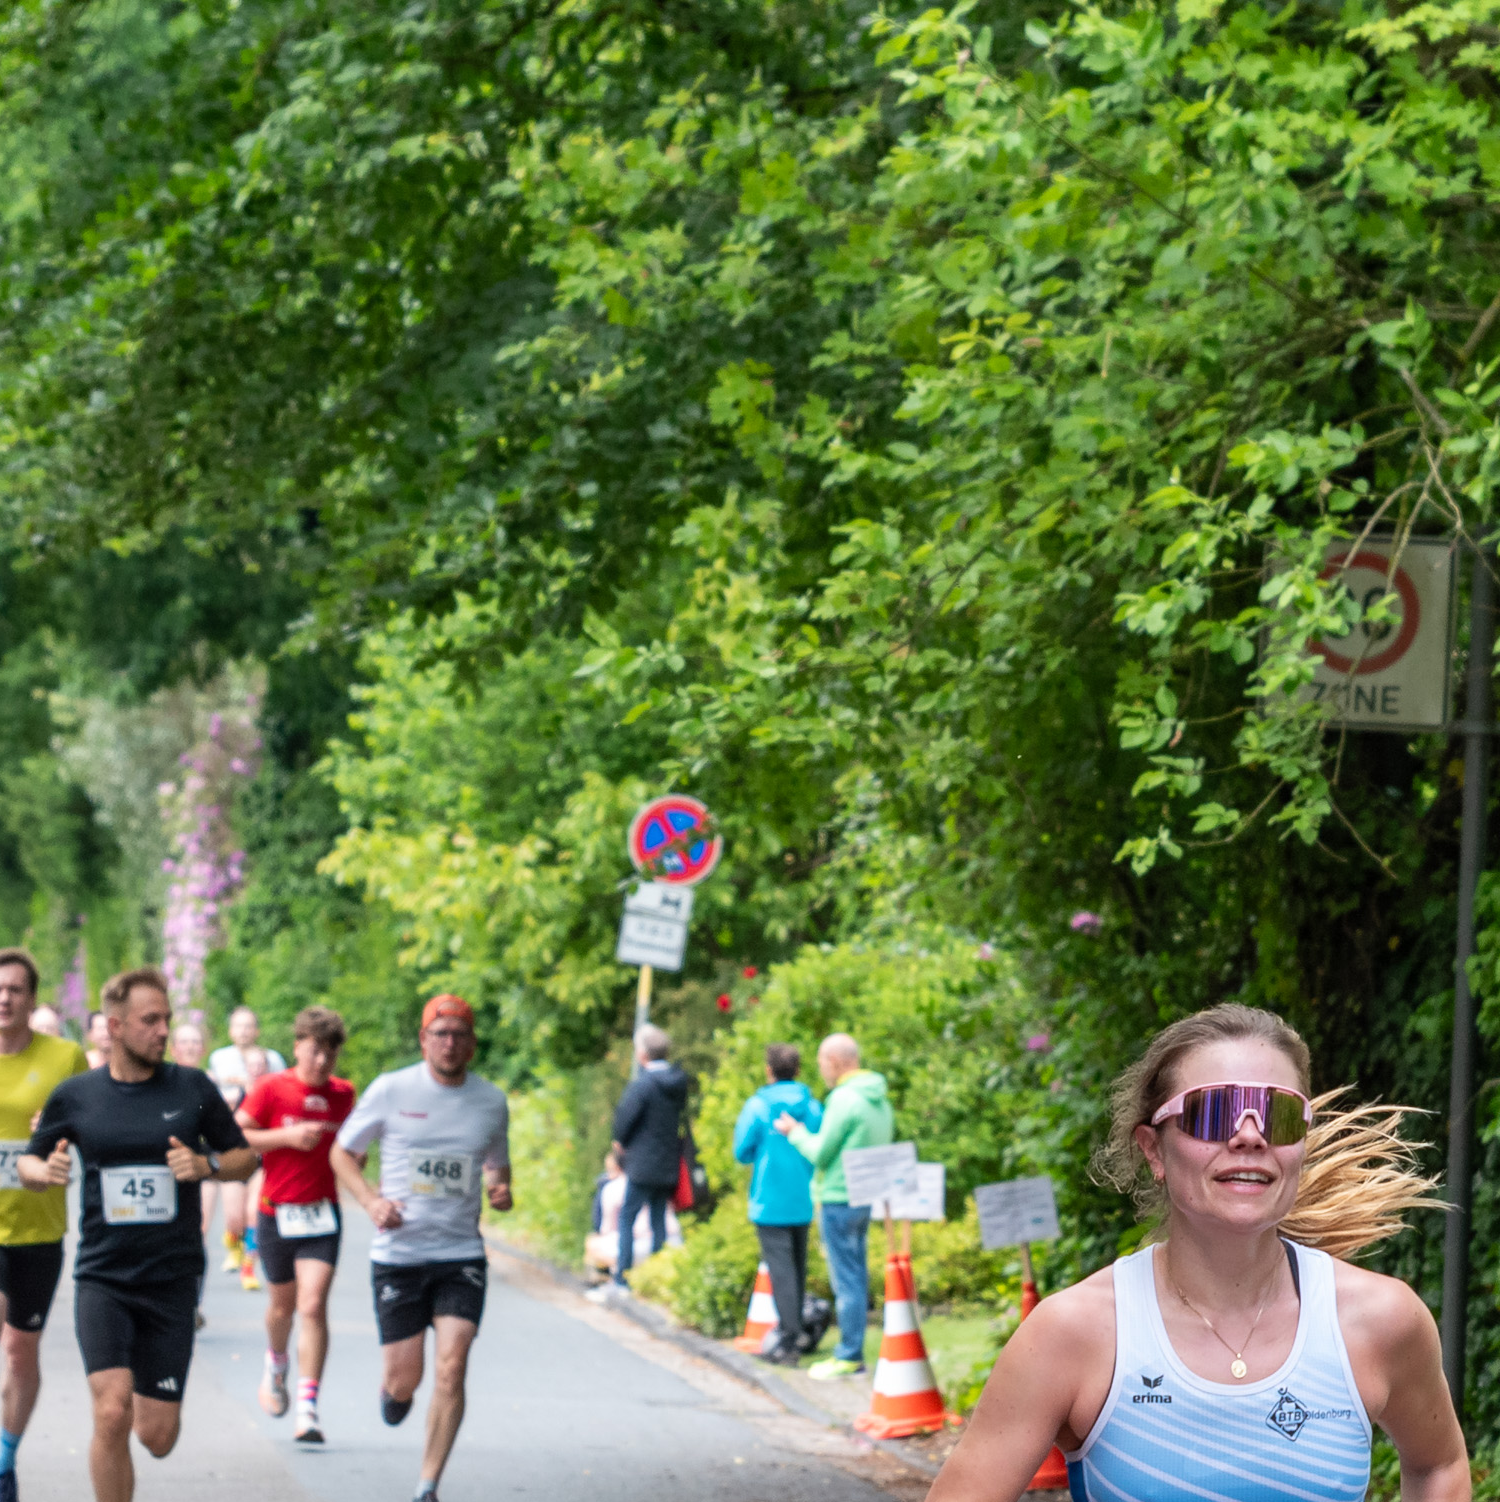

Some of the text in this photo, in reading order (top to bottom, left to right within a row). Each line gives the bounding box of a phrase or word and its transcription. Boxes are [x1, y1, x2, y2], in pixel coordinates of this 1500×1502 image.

[417, 1160, 462, 1180] 468
[122, 1178, 155, 1198] 45
[1132, 1392, 1172, 1404] erima
[1278, 1408, 1351, 1422] BTB Oldenburg
